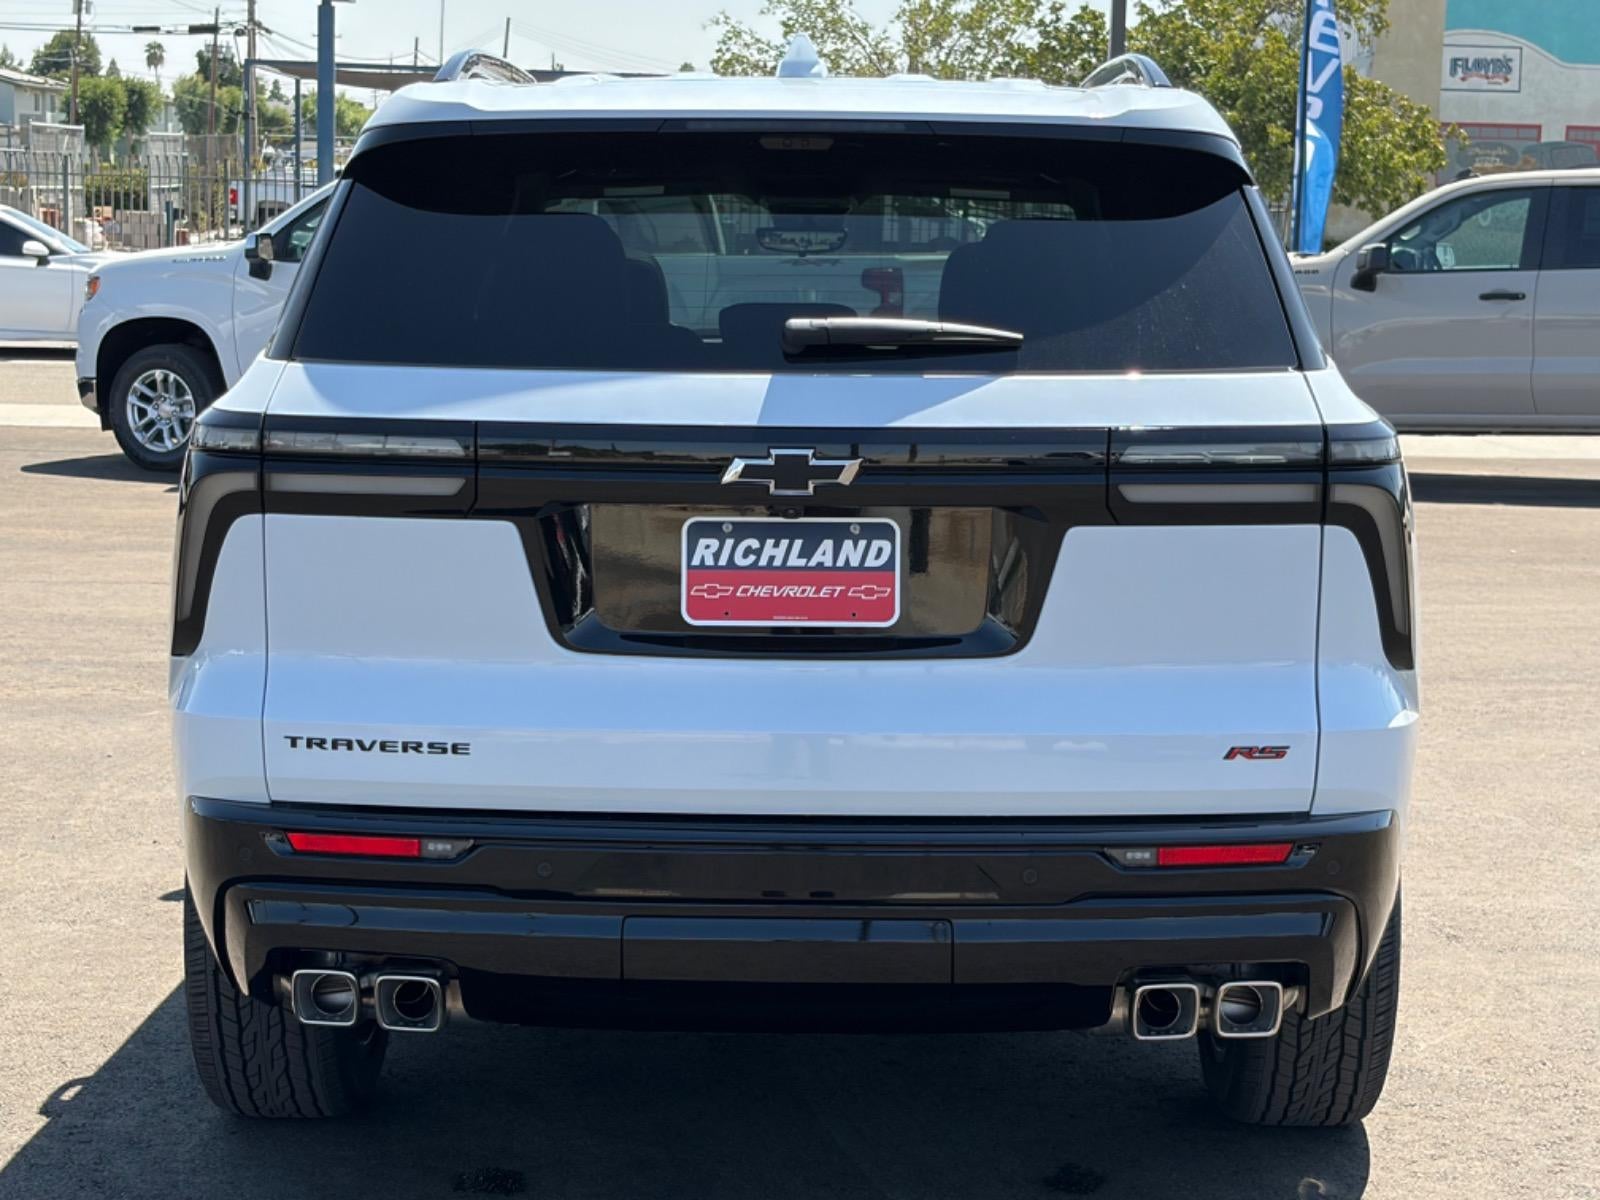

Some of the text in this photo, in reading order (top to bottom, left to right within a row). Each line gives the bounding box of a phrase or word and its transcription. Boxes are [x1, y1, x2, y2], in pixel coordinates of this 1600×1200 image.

[691, 537, 892, 567] RICHLAND
[736, 585, 845, 598] CHEVROLET
[283, 735, 471, 755] TRAVERSE
[1223, 745, 1290, 760] RS
